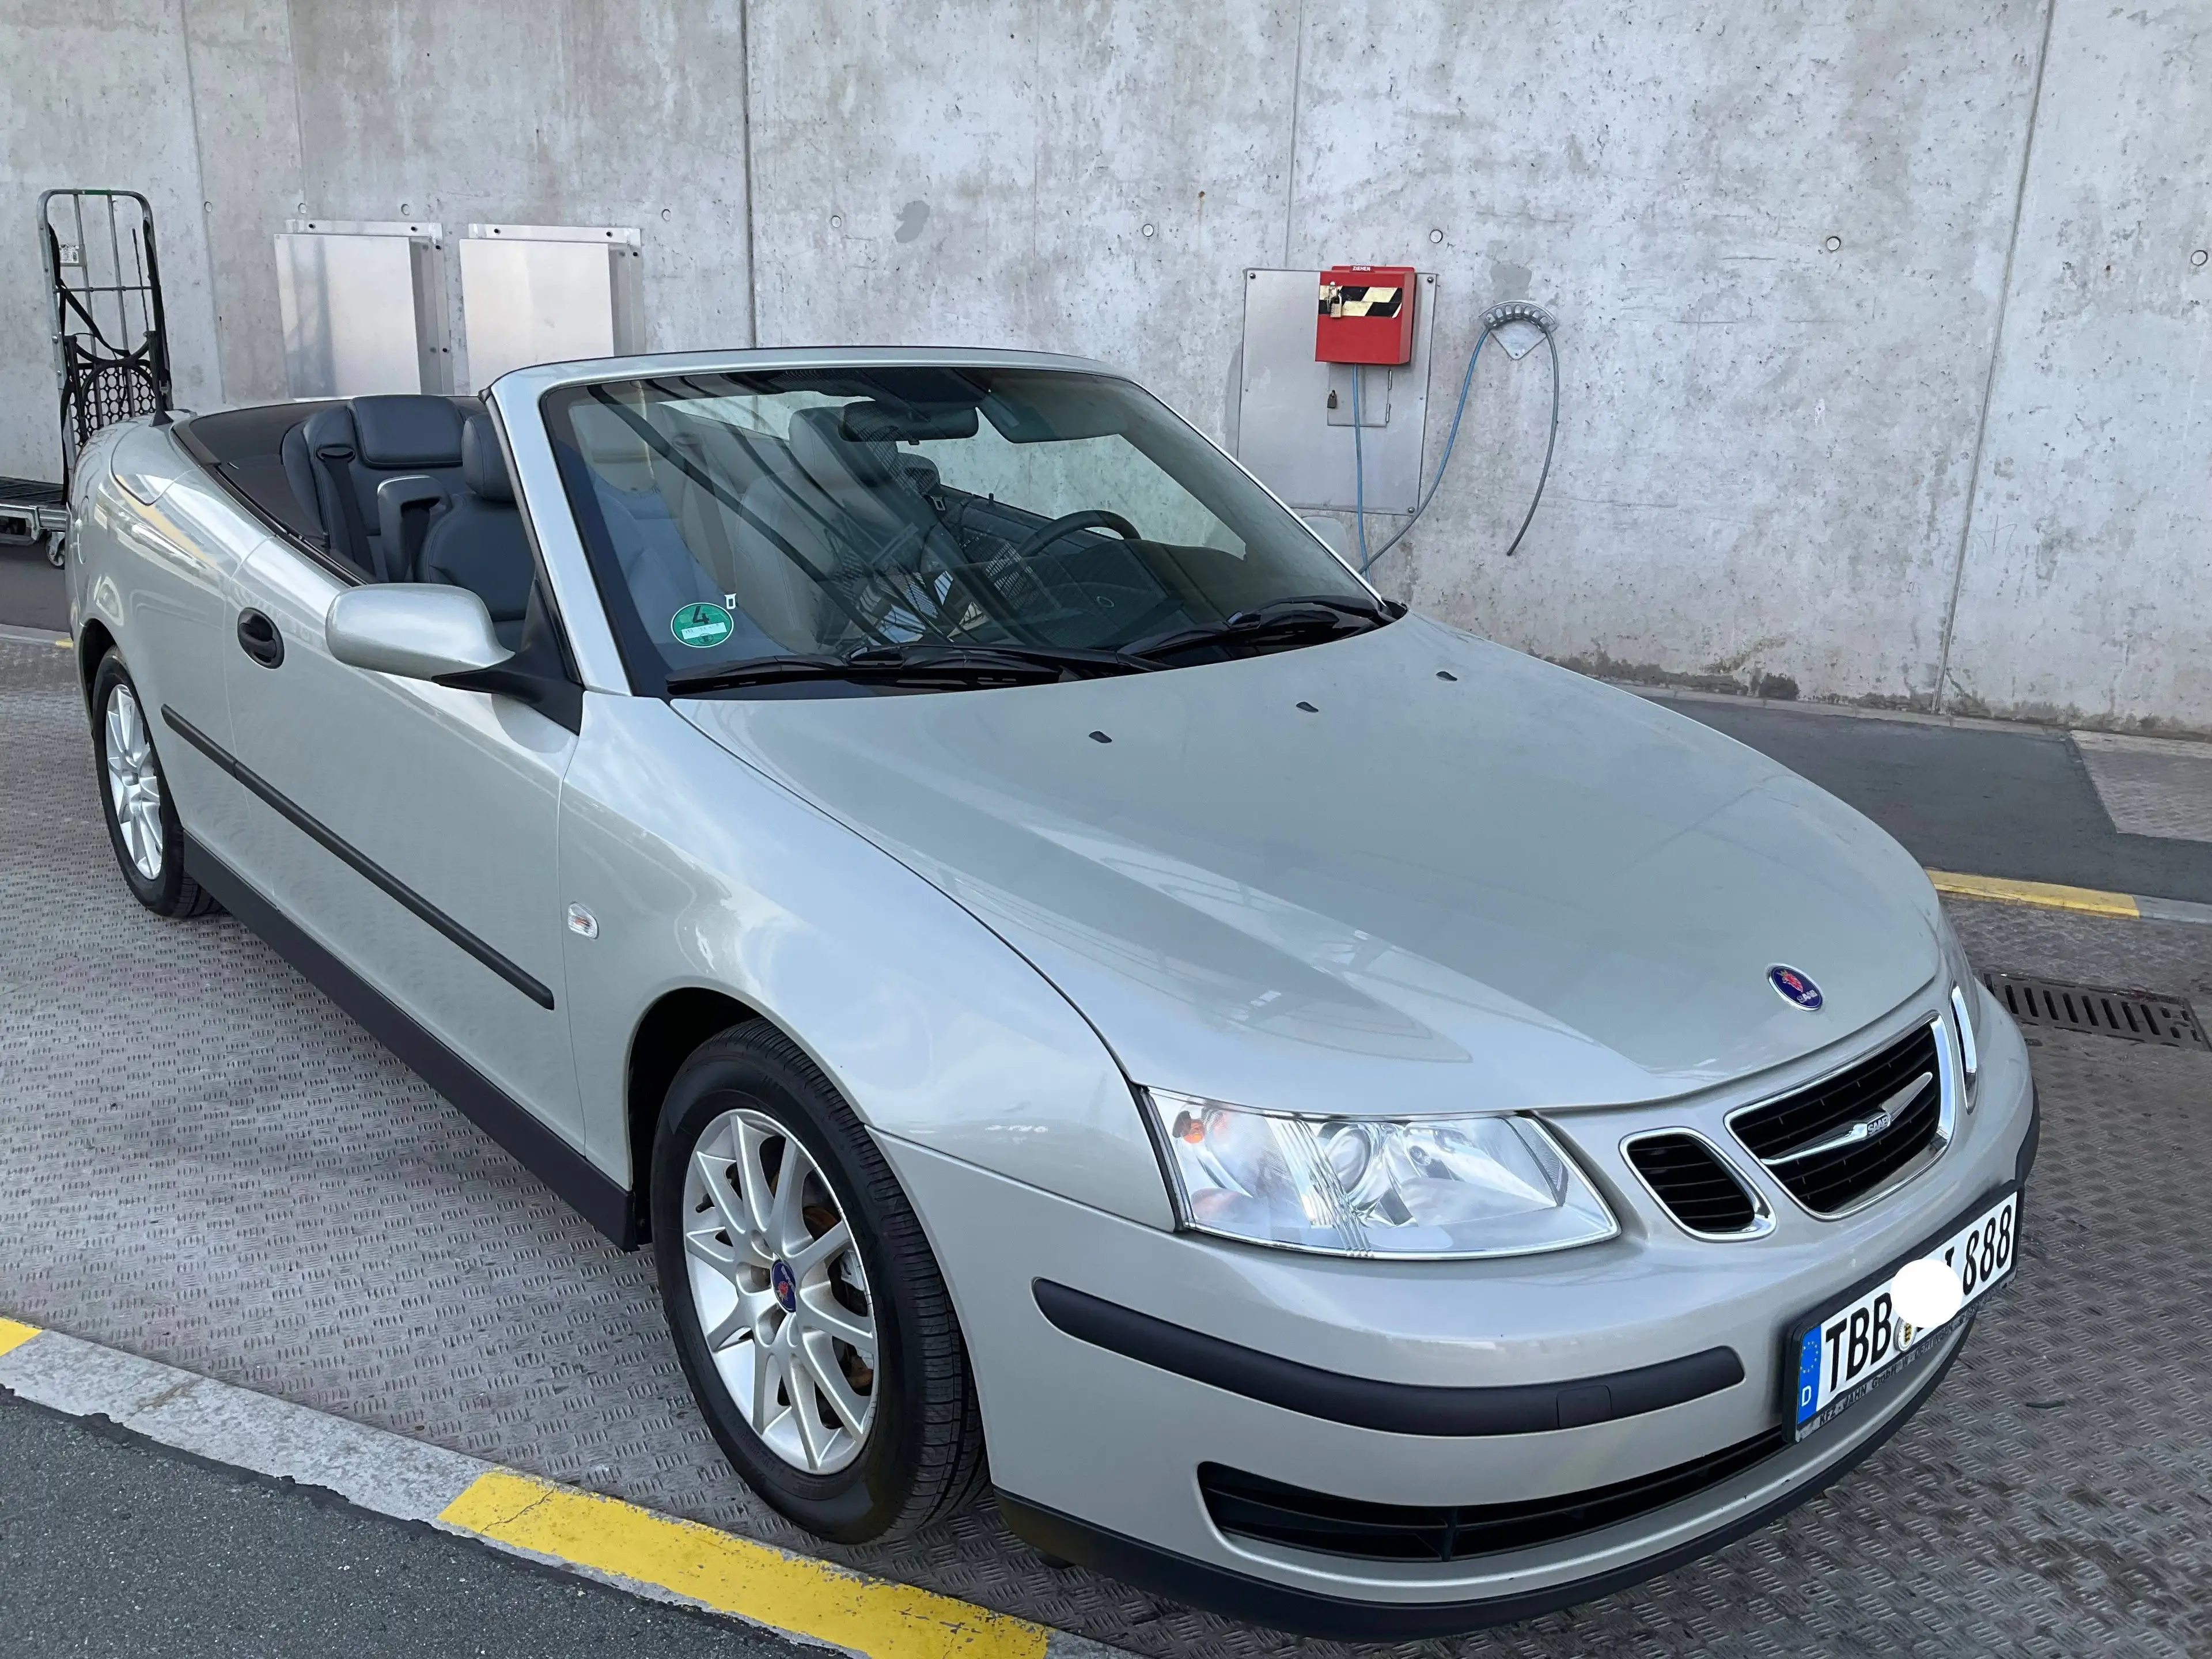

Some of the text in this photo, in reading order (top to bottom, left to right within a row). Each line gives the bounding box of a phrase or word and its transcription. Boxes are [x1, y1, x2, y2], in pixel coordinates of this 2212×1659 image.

[693, 606, 709, 624] 4
[1868, 1116, 1888, 1135] SAAB
[1825, 1292, 1892, 1392] TBB
[1963, 1205, 2012, 1296] 888
[1801, 1385, 1812, 1407] D
